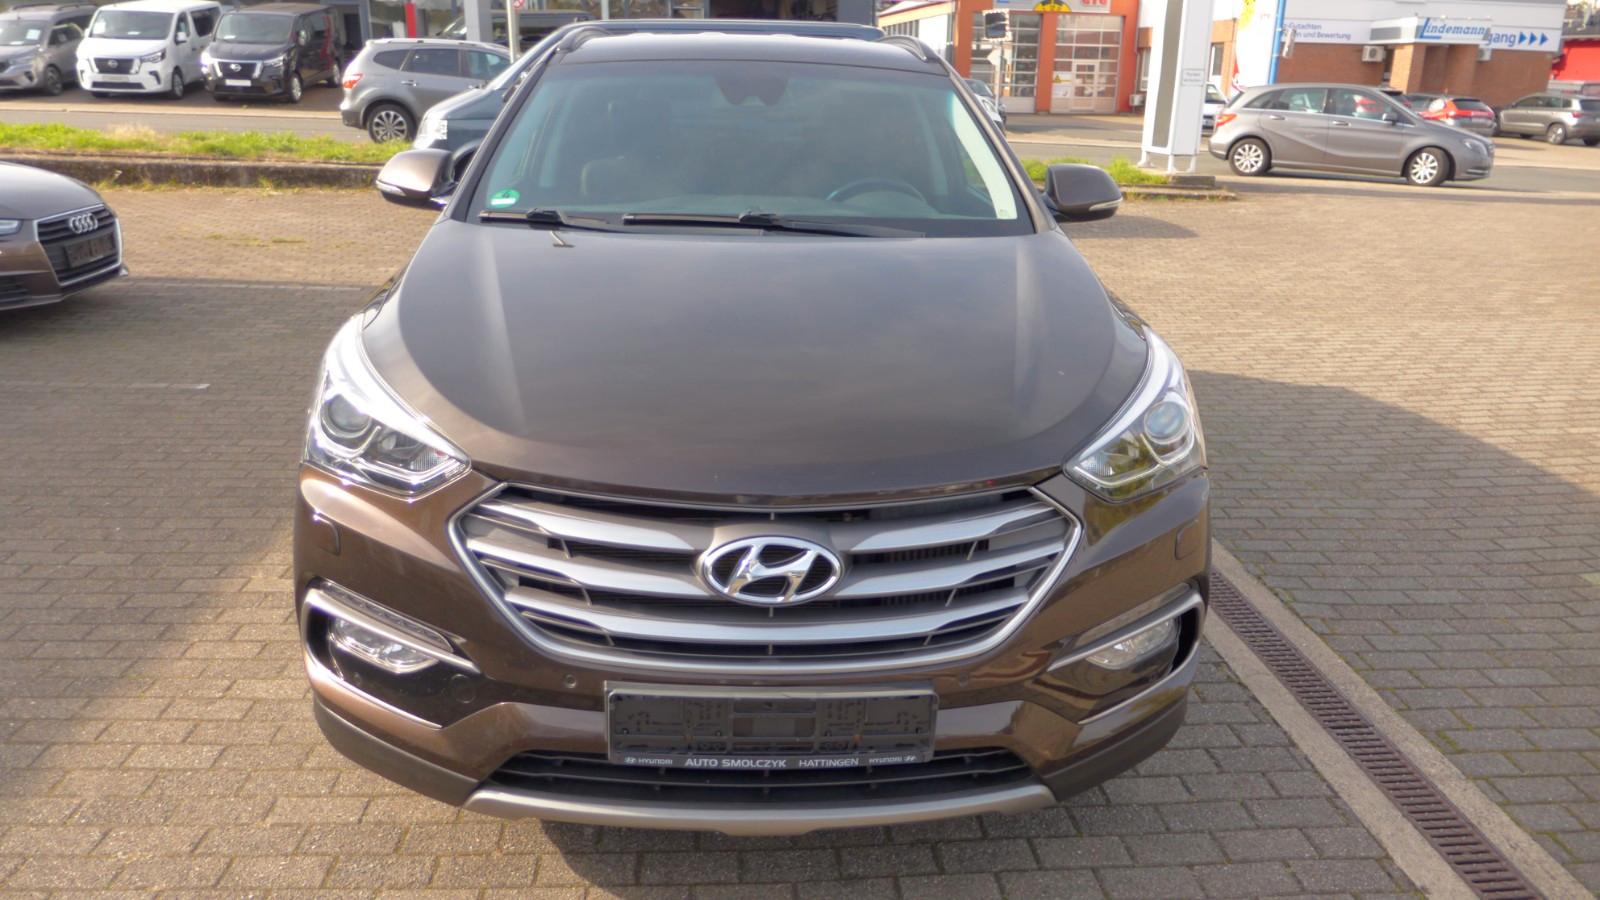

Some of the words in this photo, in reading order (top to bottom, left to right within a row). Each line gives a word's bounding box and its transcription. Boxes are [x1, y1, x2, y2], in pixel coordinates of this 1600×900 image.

[1317, 32, 1351, 41] Bewertung
[684, 758, 718, 767] AUTO
[721, 758, 786, 768] SMOLCZYK
[799, 758, 859, 767] HATTINGEN
